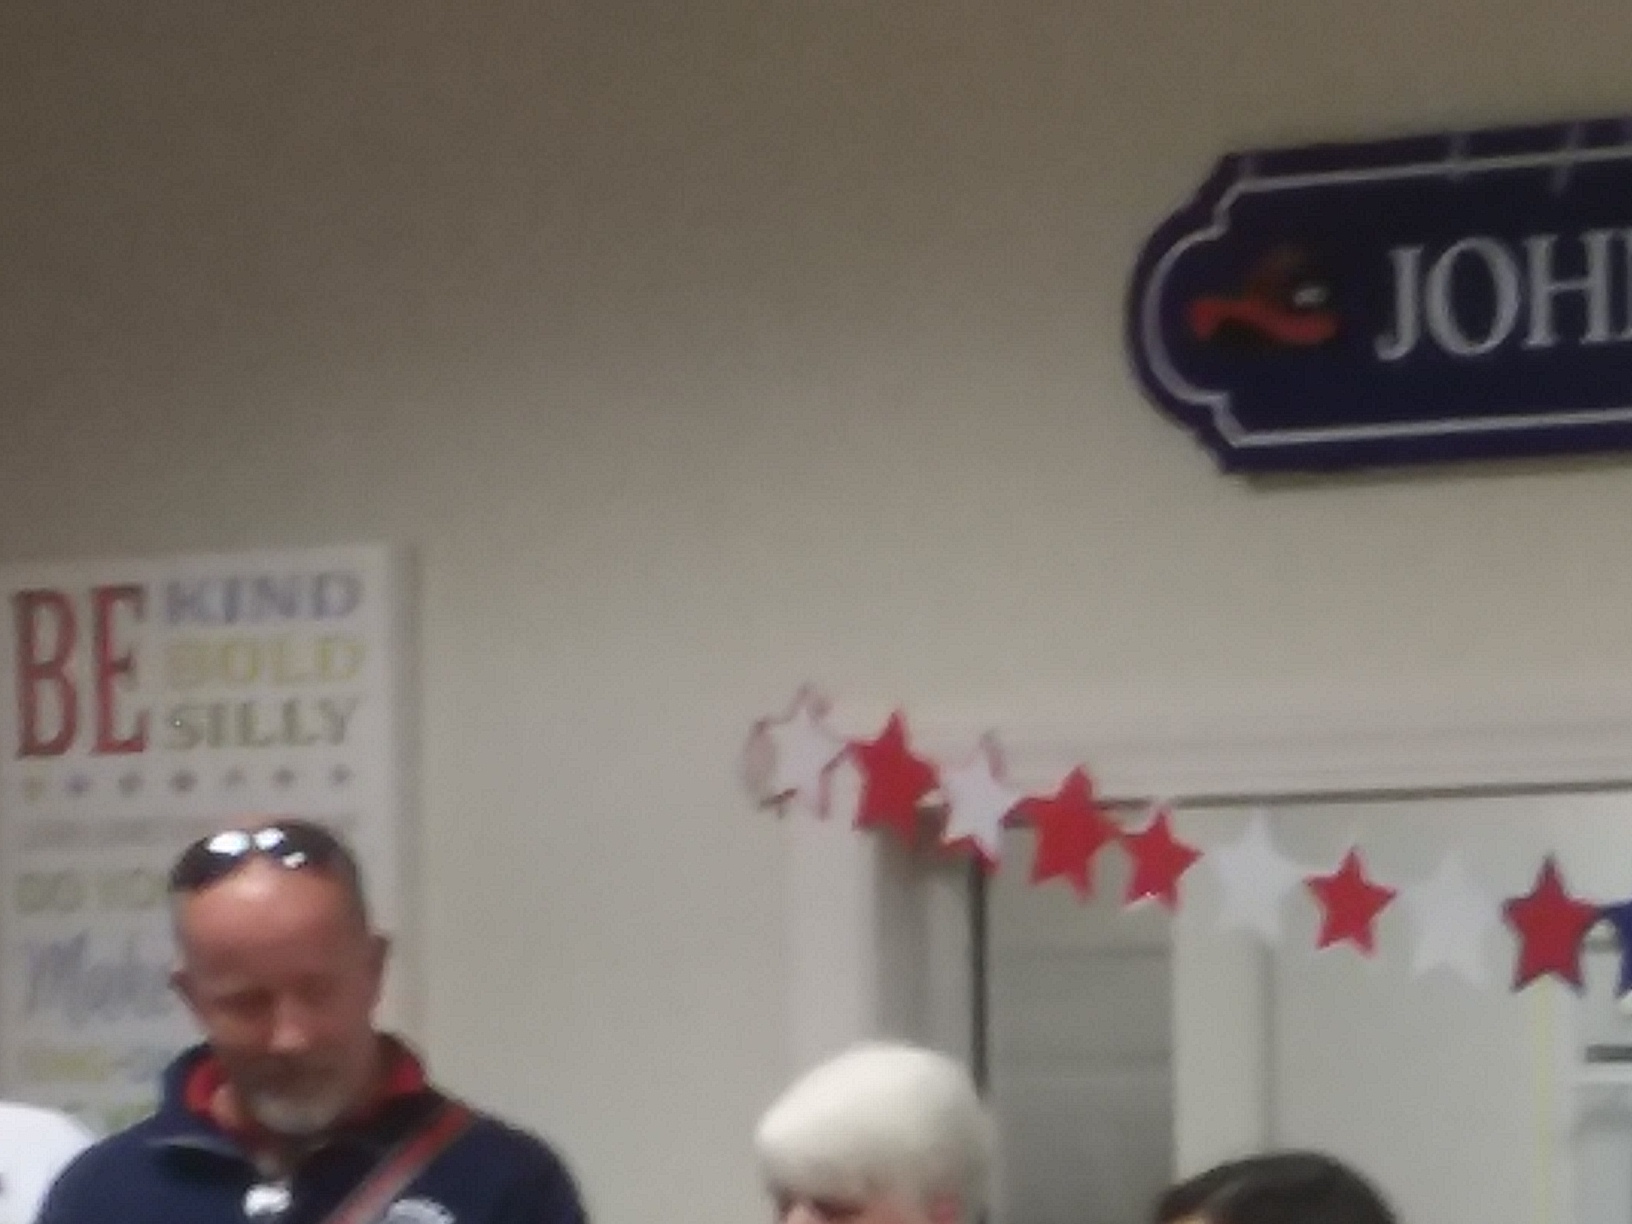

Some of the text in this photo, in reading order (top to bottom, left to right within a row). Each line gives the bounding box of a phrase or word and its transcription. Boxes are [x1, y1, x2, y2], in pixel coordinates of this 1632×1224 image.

[164, 571, 363, 626] KIND
[13, 582, 149, 759] BE
[164, 696, 360, 750] SILLY
